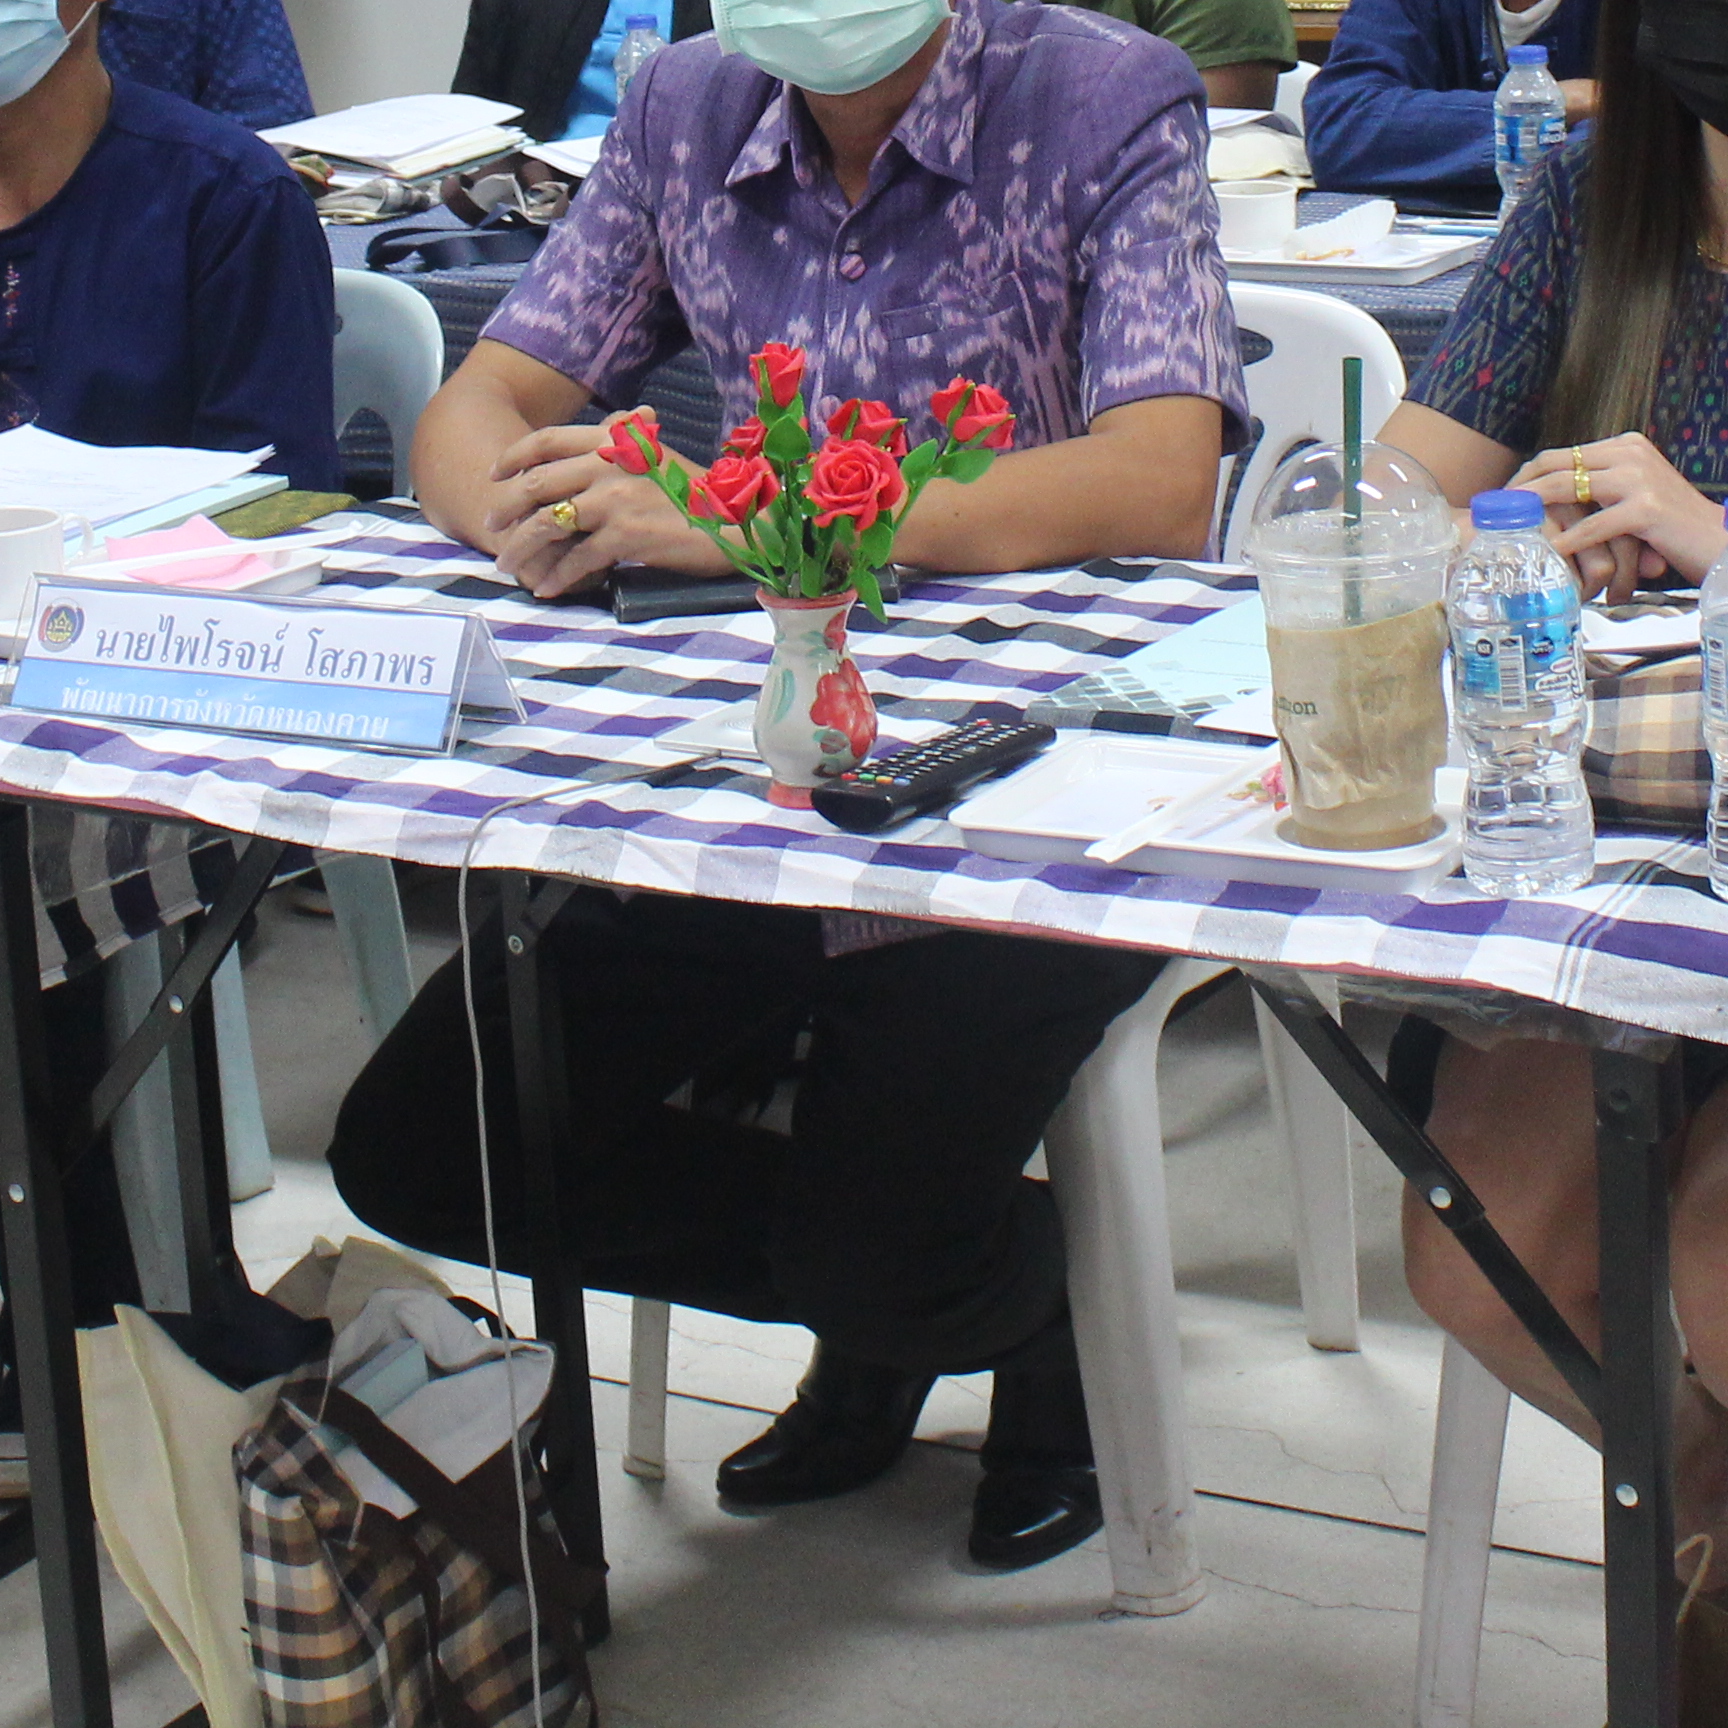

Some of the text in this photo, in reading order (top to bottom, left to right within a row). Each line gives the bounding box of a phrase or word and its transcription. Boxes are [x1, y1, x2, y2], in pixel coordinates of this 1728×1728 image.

[95, 613, 437, 687] นายไพโรจน์ โสภาพร
[60, 677, 390, 740] พัฒนาการจังหวัดหนองคาย
